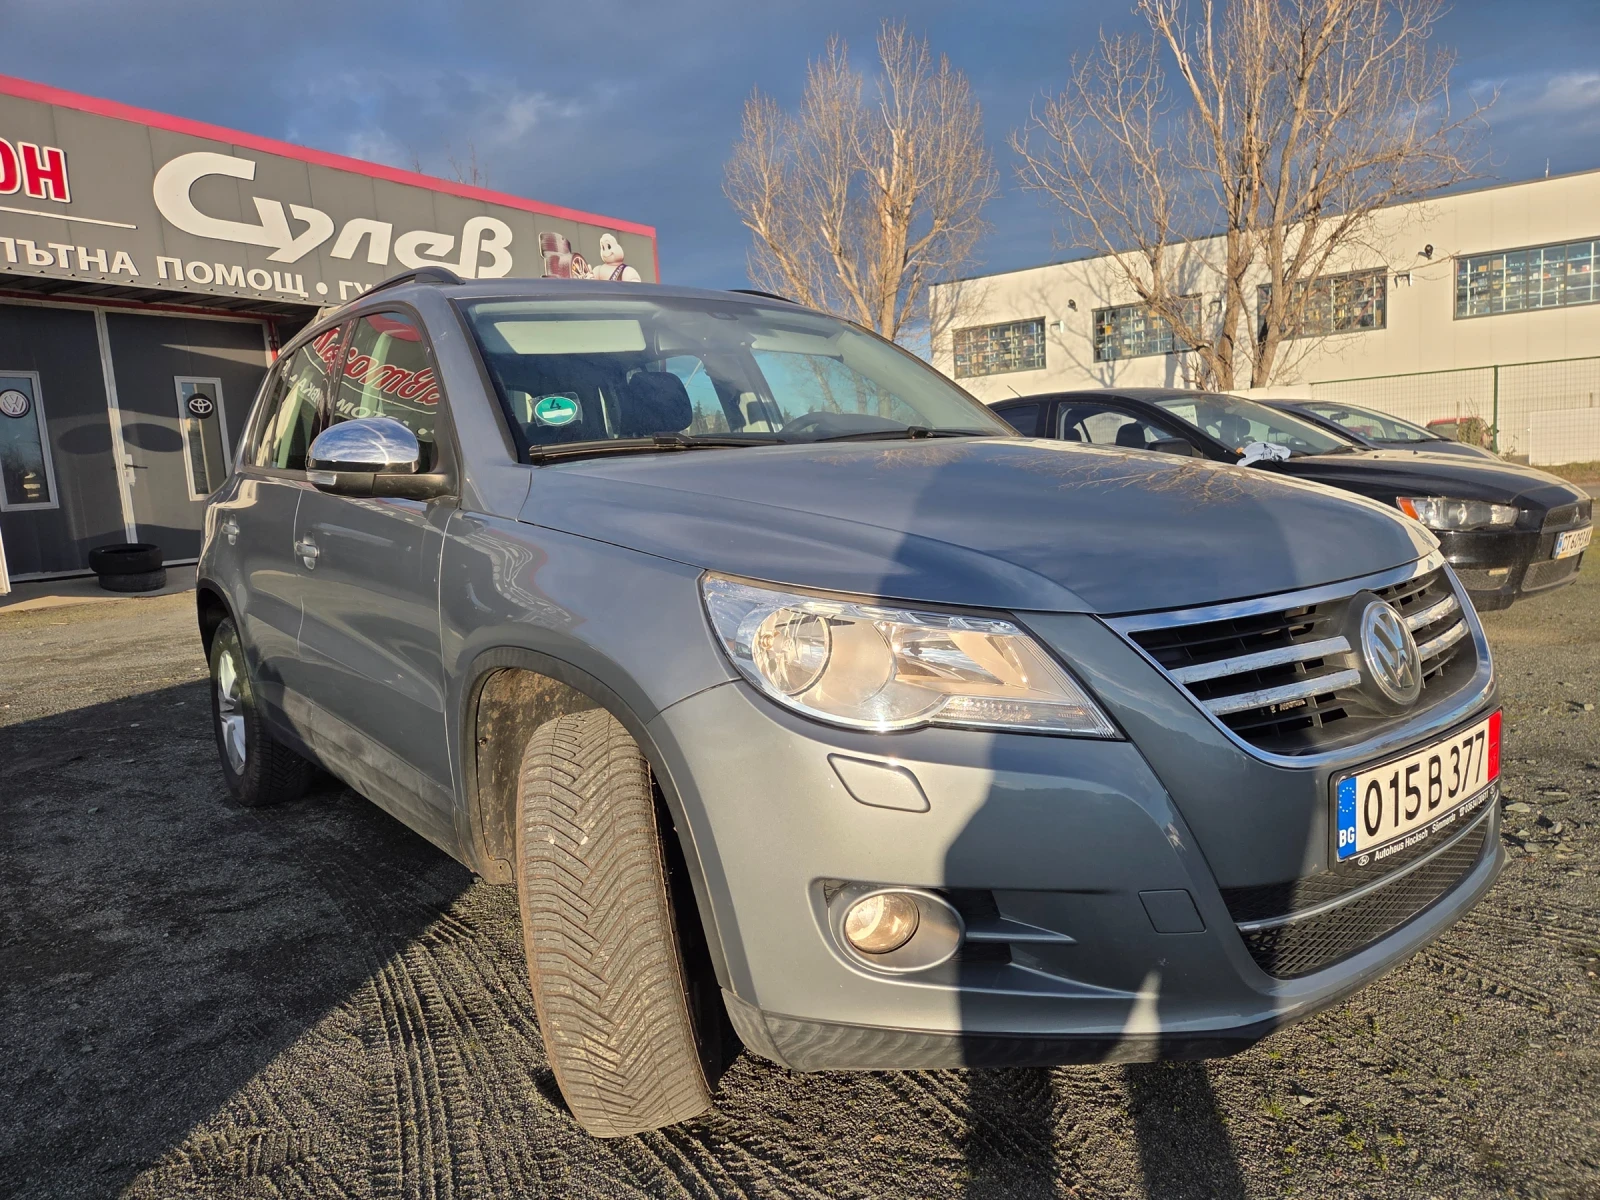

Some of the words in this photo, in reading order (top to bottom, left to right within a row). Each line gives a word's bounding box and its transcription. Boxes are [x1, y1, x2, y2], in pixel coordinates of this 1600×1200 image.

[0, 236, 140, 276] ПЪТНА
[156, 255, 309, 298] ПОМОЩ
[338, 280, 376, 301] ГУ
[1338, 826, 1356, 848] BG
[1374, 841, 1405, 862] Autohaus
